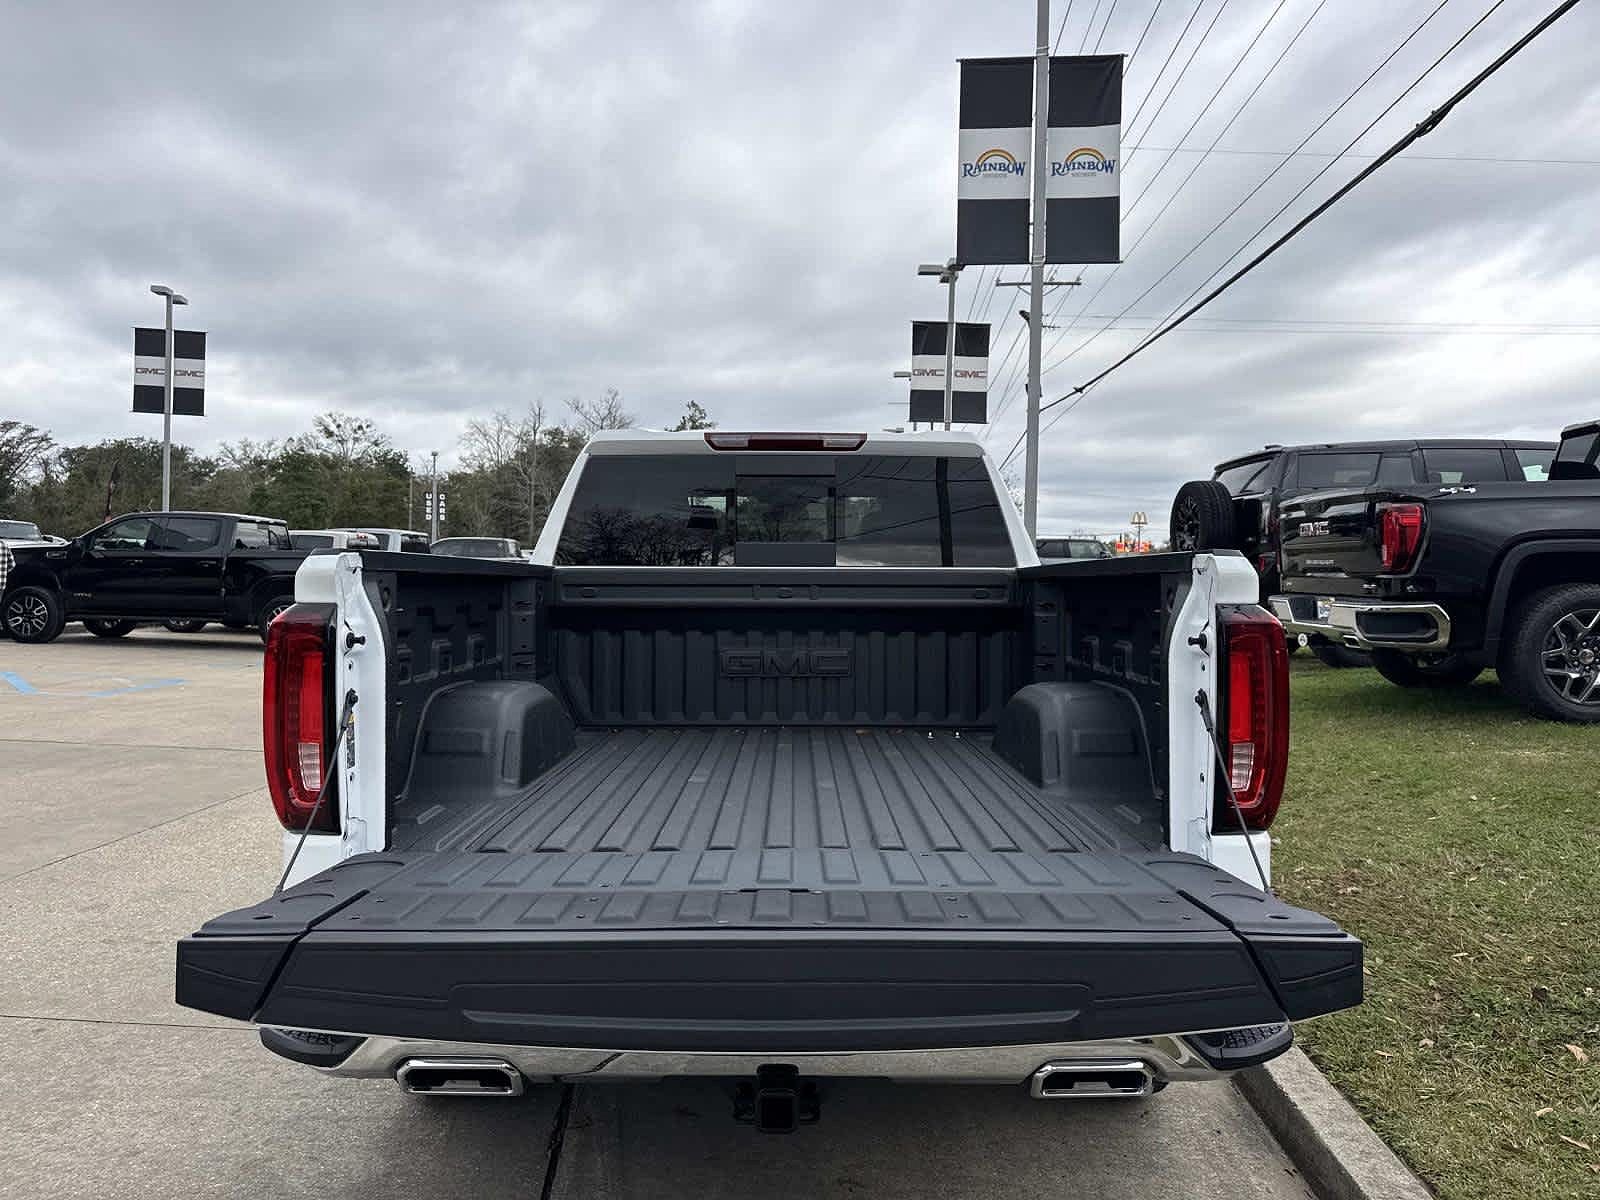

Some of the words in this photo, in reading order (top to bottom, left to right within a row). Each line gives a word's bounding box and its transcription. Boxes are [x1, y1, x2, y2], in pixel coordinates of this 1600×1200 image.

[962, 161, 1026, 177] RAINBOW
[1051, 159, 1116, 177] RAINBOW
[136, 367, 165, 375] GMC
[175, 369, 204, 377] GMC
[955, 370, 987, 378] GMC
[425, 492, 433, 520] USED
[1299, 521, 1330, 536] GMC
[719, 647, 852, 679] GMC
